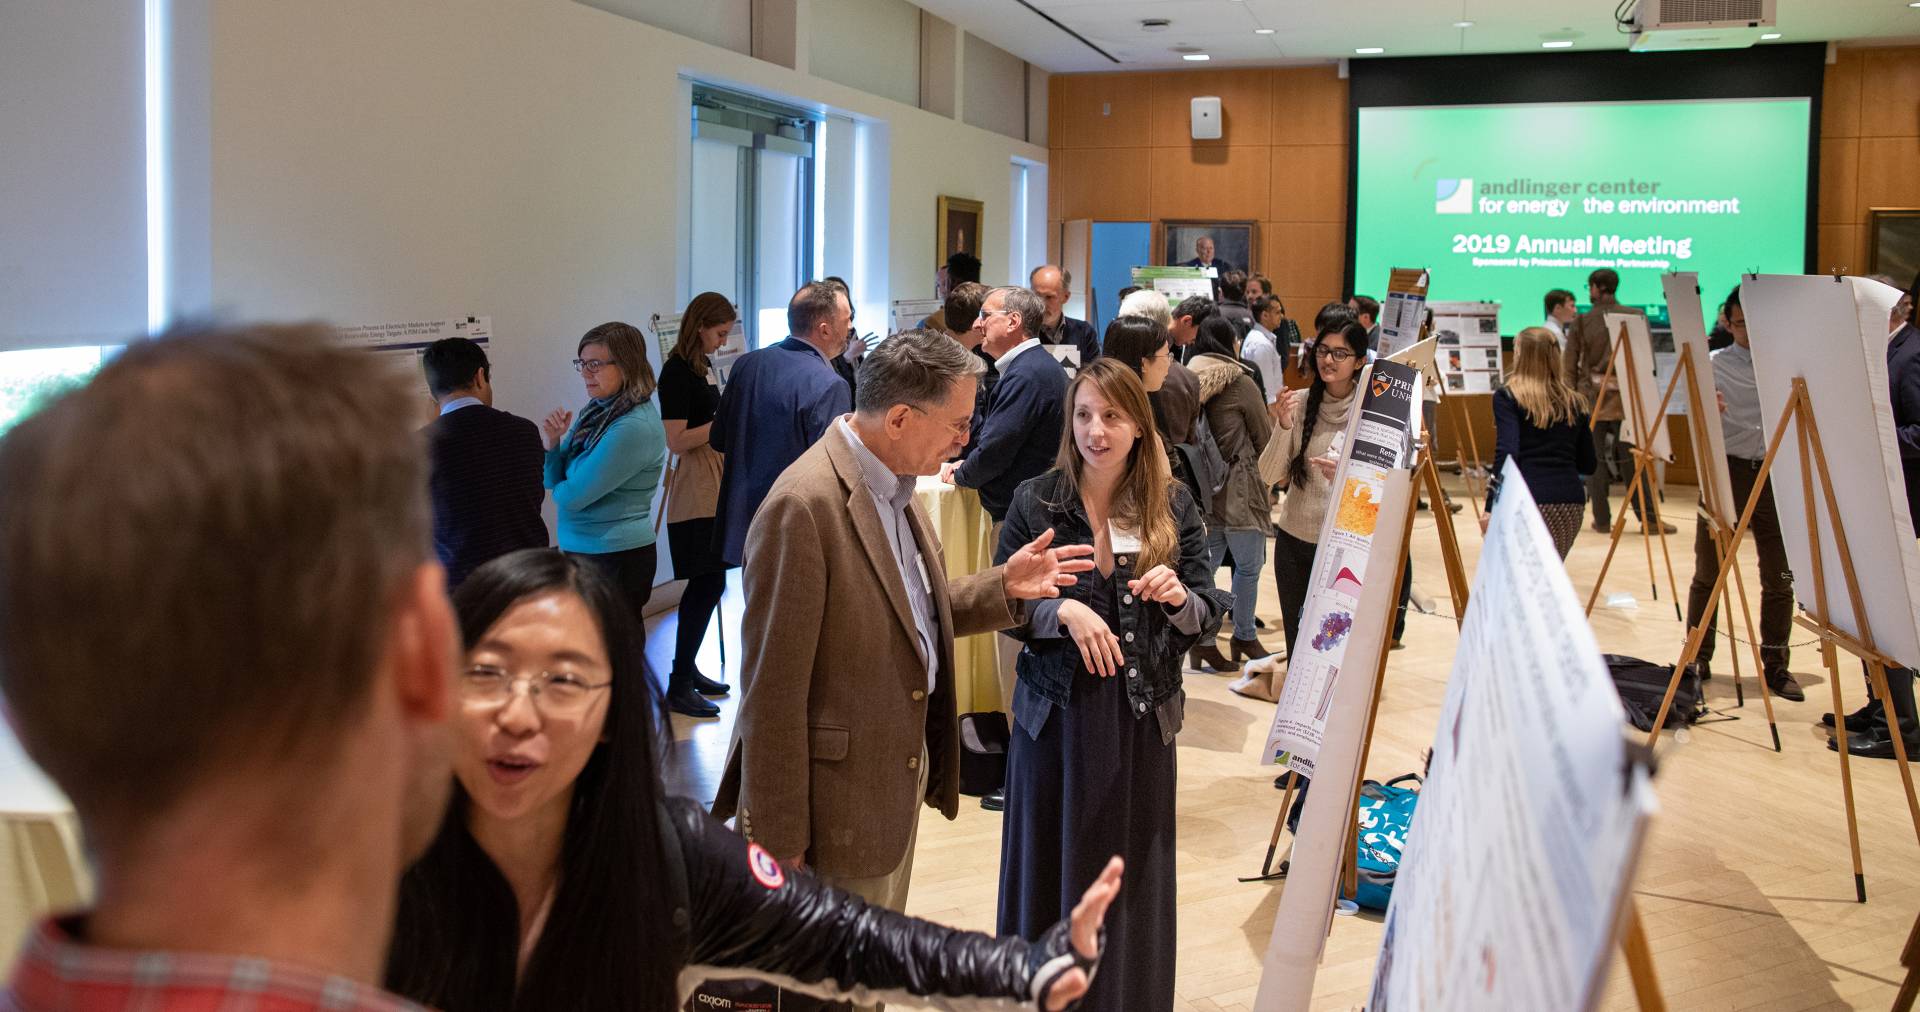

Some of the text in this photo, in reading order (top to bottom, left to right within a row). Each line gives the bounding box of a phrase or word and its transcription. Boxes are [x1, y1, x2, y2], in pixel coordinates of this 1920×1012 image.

[1479, 178, 1661, 198] andlinger center
[1478, 196, 1741, 217] for energy the environment
[1452, 233, 1693, 259] 2019 Annual Meeting
[1472, 257, 1517, 267] Sponsored
[1519, 257, 1529, 268] by
[1531, 257, 1573, 267] Princeton
[698, 993, 731, 1009] axiom
